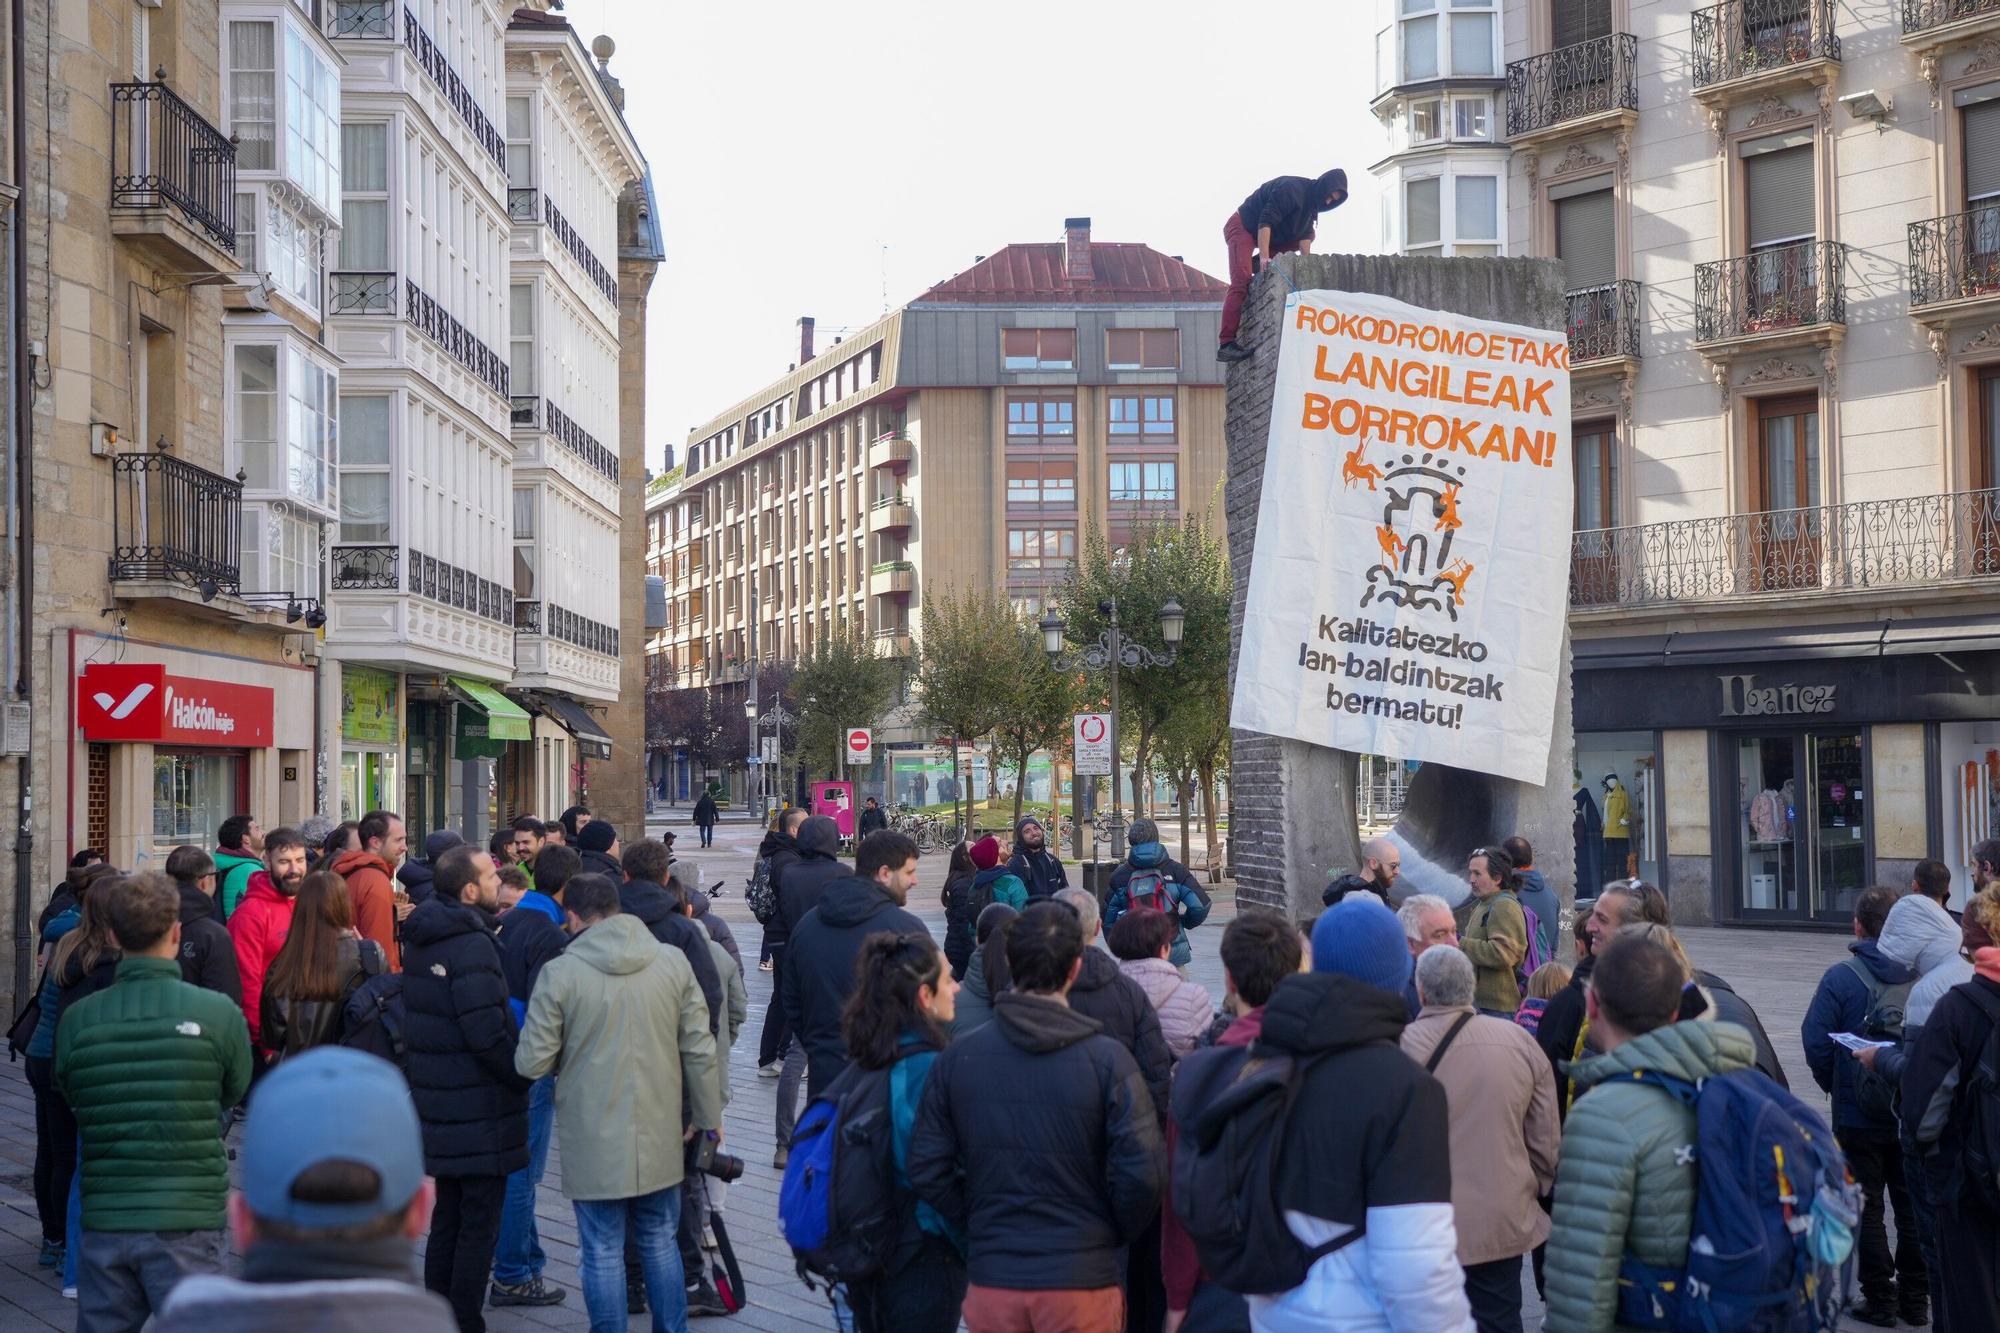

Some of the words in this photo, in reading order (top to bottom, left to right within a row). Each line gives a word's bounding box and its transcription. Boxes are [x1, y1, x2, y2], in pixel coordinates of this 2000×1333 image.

[1314, 345, 1553, 416] LANGILEAK
[1302, 392, 1556, 467] BORROKAN!
[1318, 614, 1488, 662] Kalitatezko
[1299, 642, 1504, 701] lan-baldintzak
[172, 697, 215, 730] Halcón
[215, 713, 234, 735] viajes
[1326, 683, 1463, 730] bermatu!
[286, 768, 294, 779] 3
